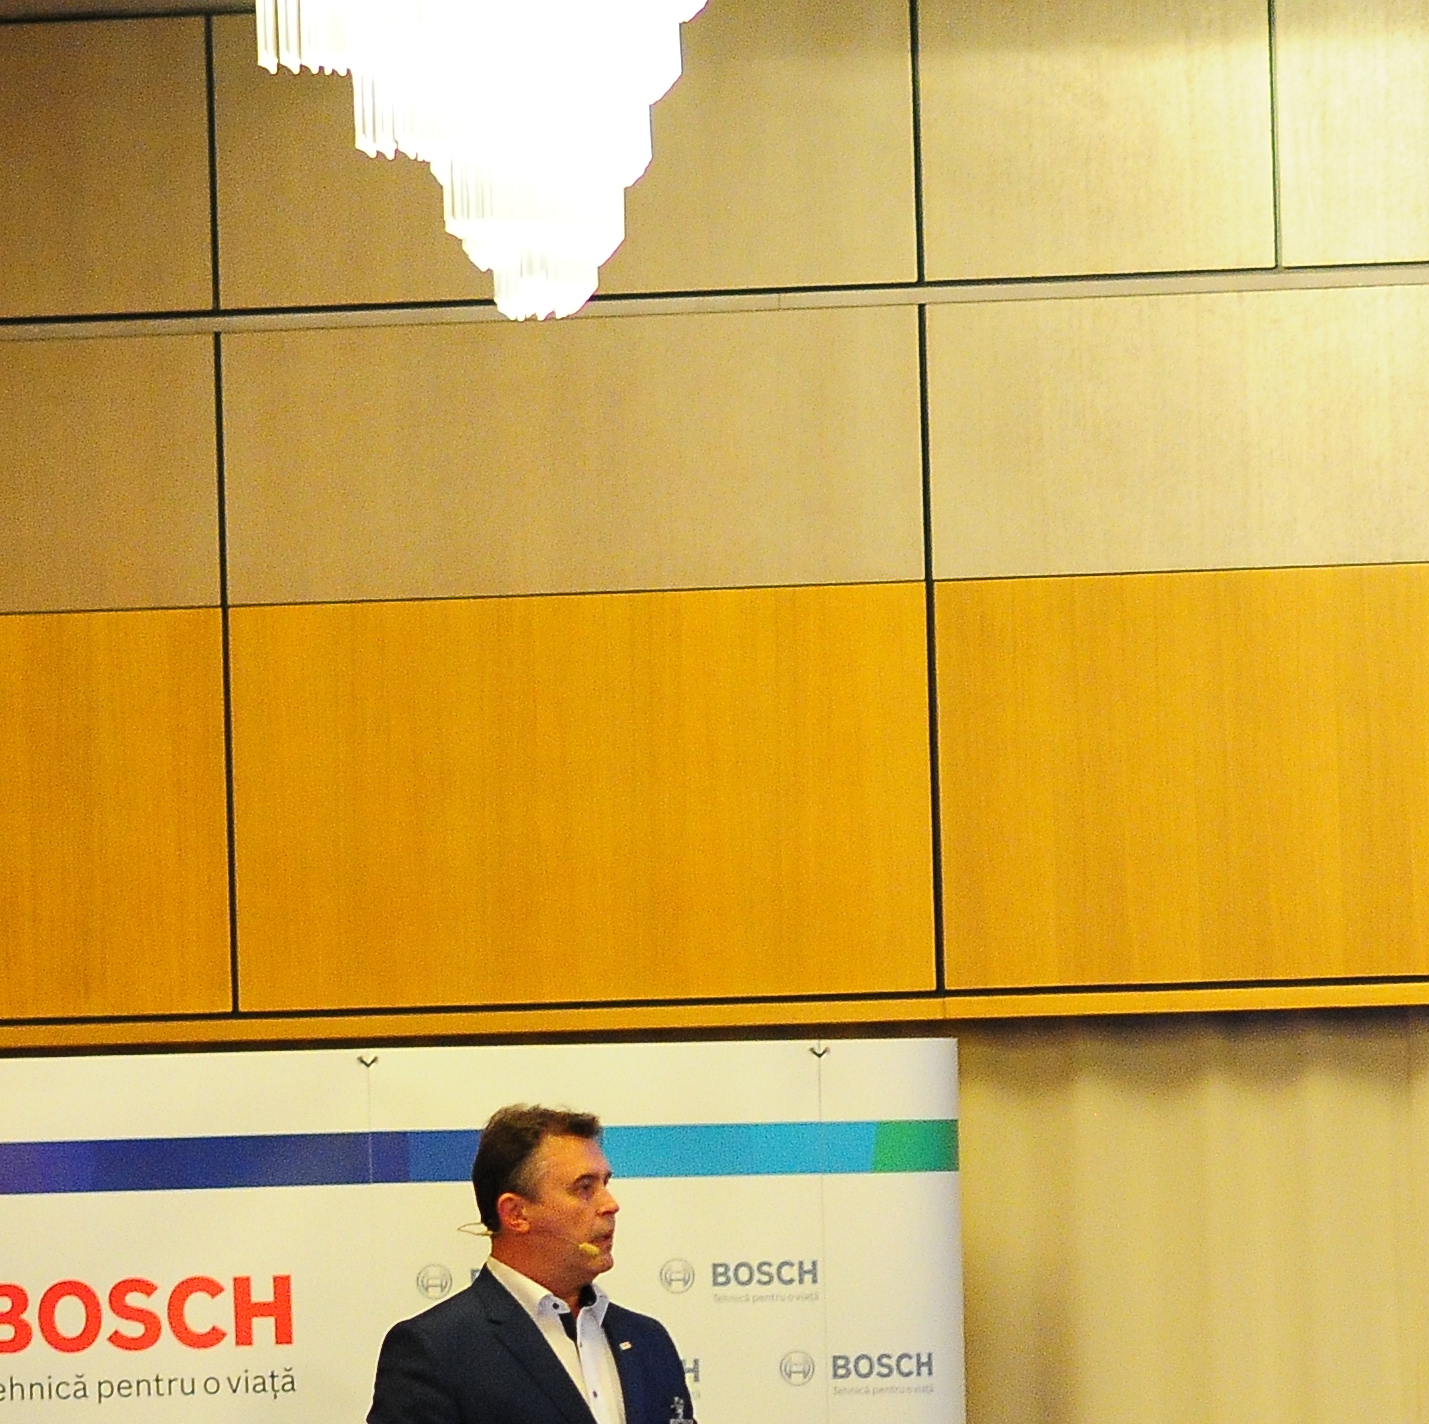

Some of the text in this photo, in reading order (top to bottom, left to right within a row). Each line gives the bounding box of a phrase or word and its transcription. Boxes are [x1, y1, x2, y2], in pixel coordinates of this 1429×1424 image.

[711, 1259, 819, 1287] BOSCH
[831, 1352, 934, 1380] BOSCH
[0, 1366, 297, 1404] hnică pentru o viață
